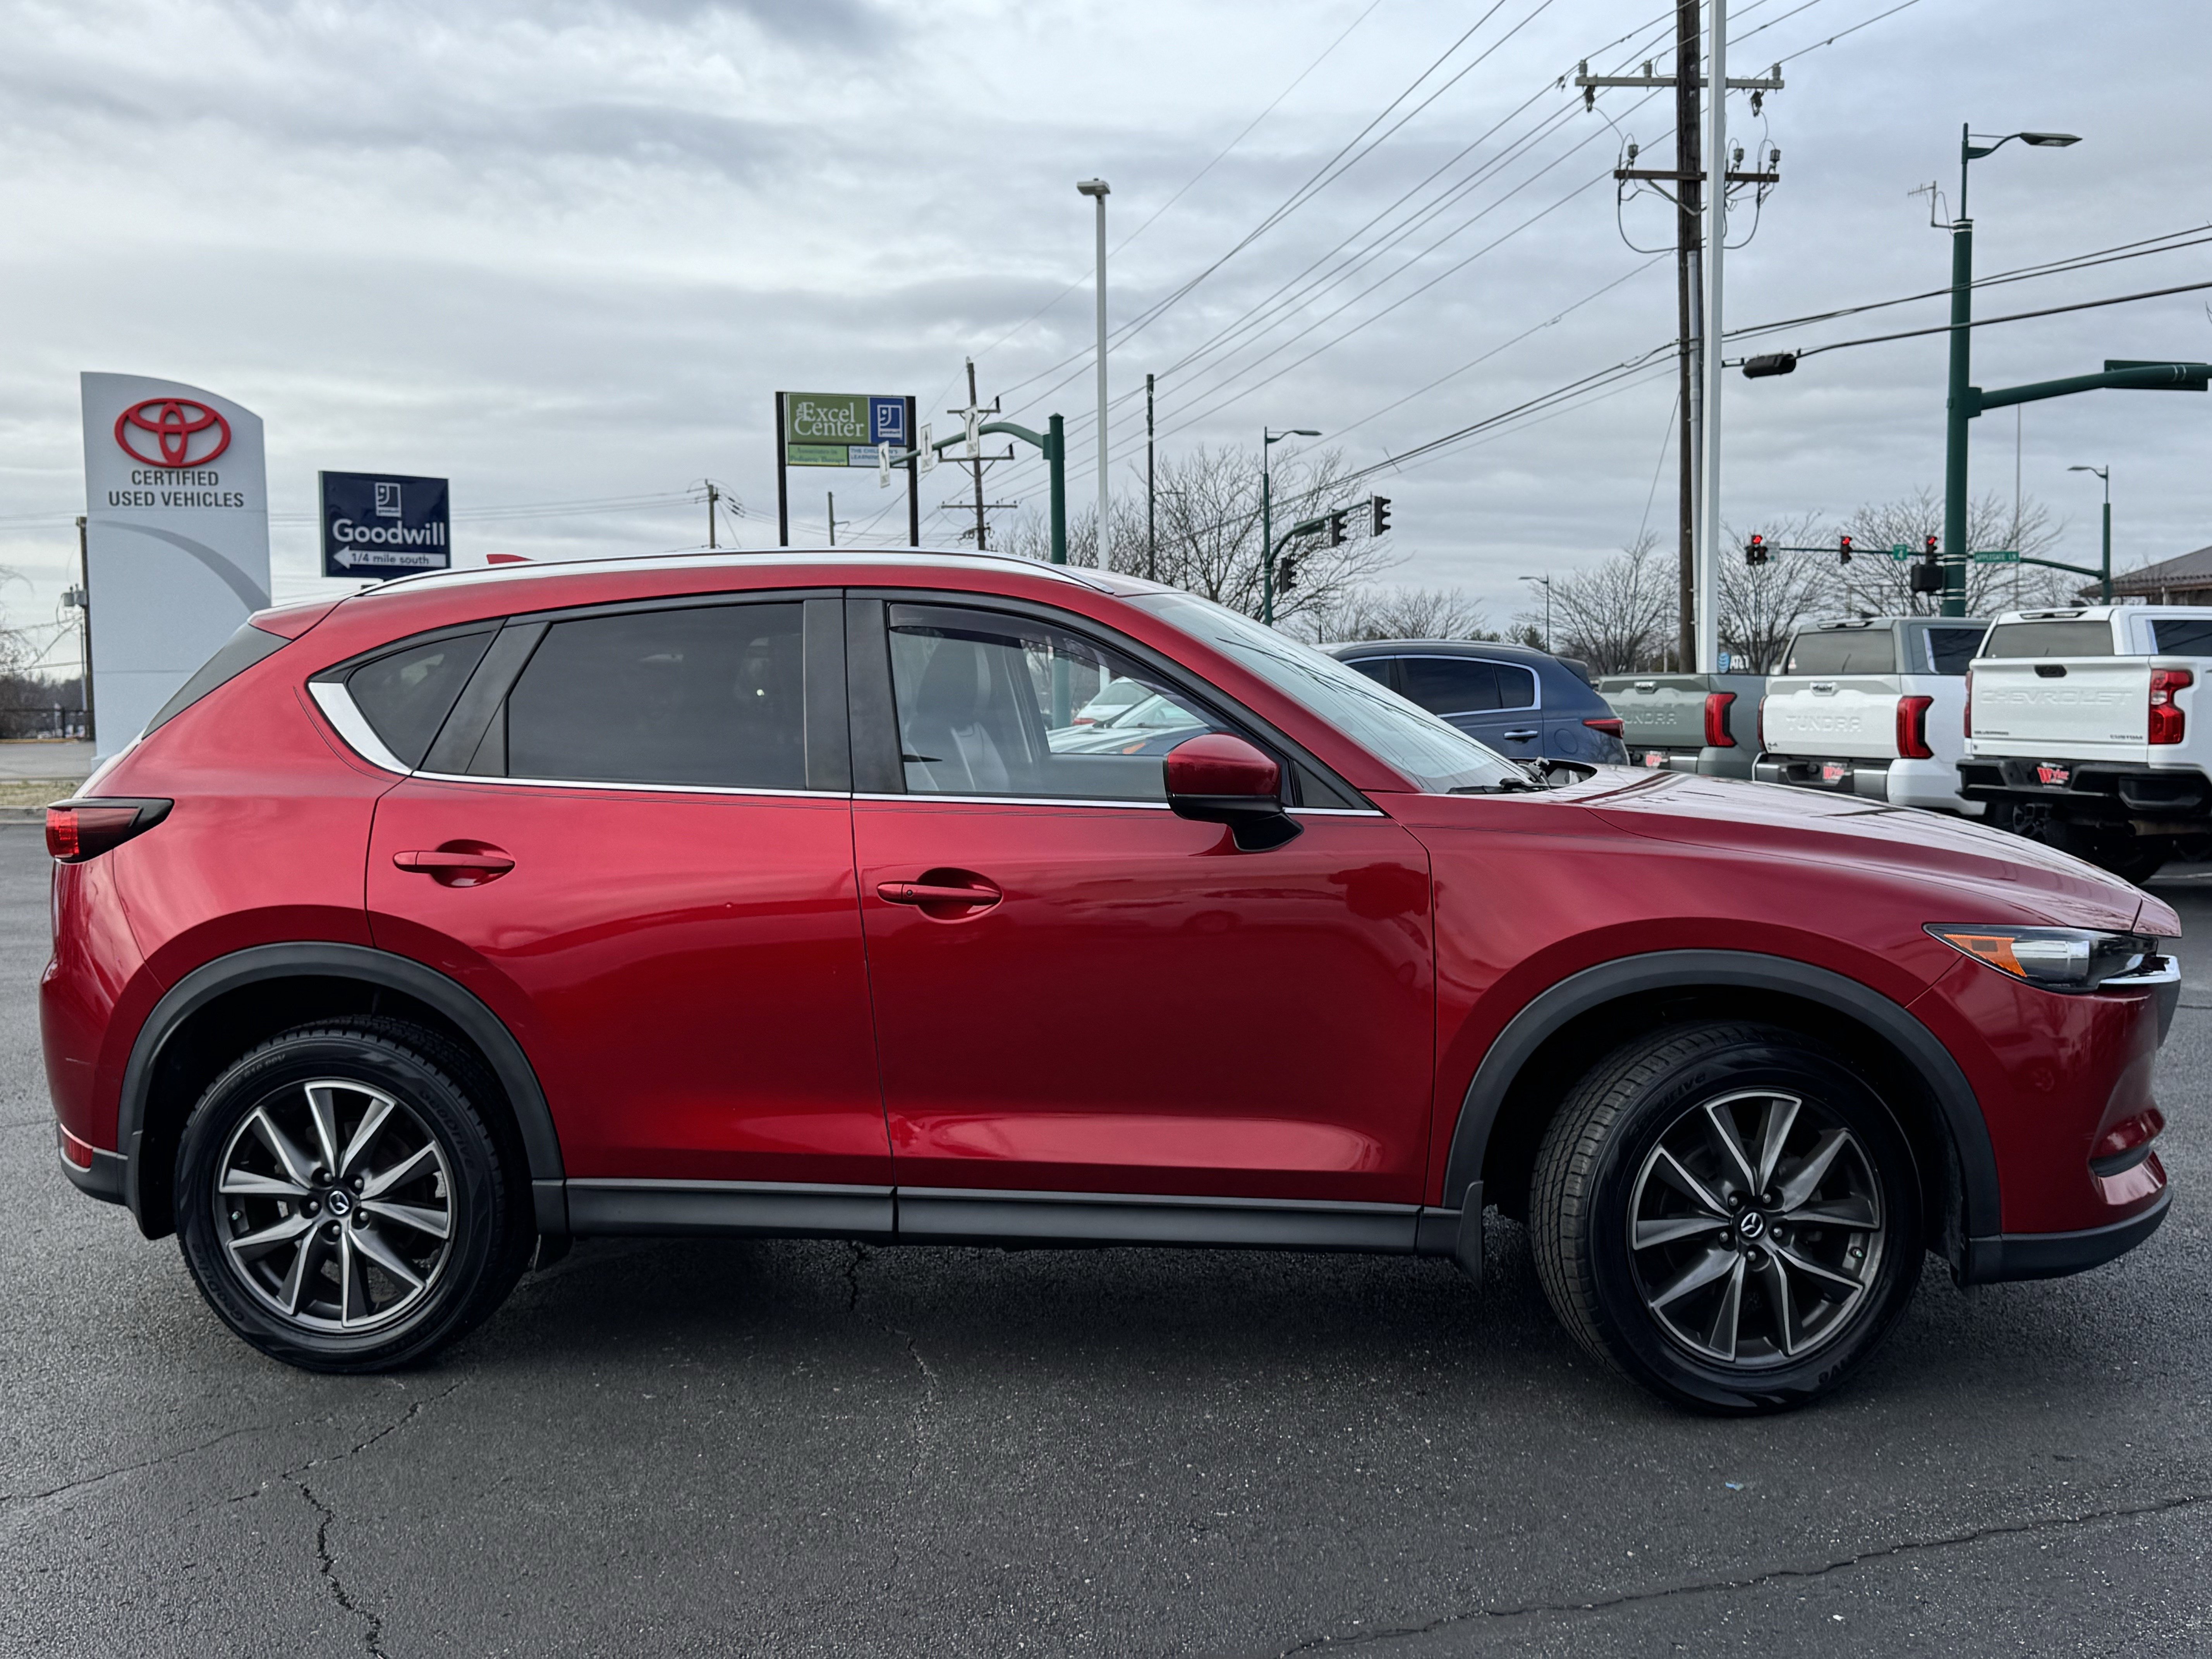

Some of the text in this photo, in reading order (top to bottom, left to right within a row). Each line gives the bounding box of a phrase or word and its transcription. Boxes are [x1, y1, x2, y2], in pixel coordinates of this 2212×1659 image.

[801, 401, 856, 423] Excel
[794, 416, 864, 437] Center
[132, 470, 219, 486] CERTIFIED
[108, 491, 244, 508] USED VEHICLES
[332, 518, 445, 546] Goodwill
[351, 553, 429, 564] 1/4 mile south
[1980, 690, 2133, 705] CHEVROLET
[1785, 716, 1862, 732] TUNDRA
